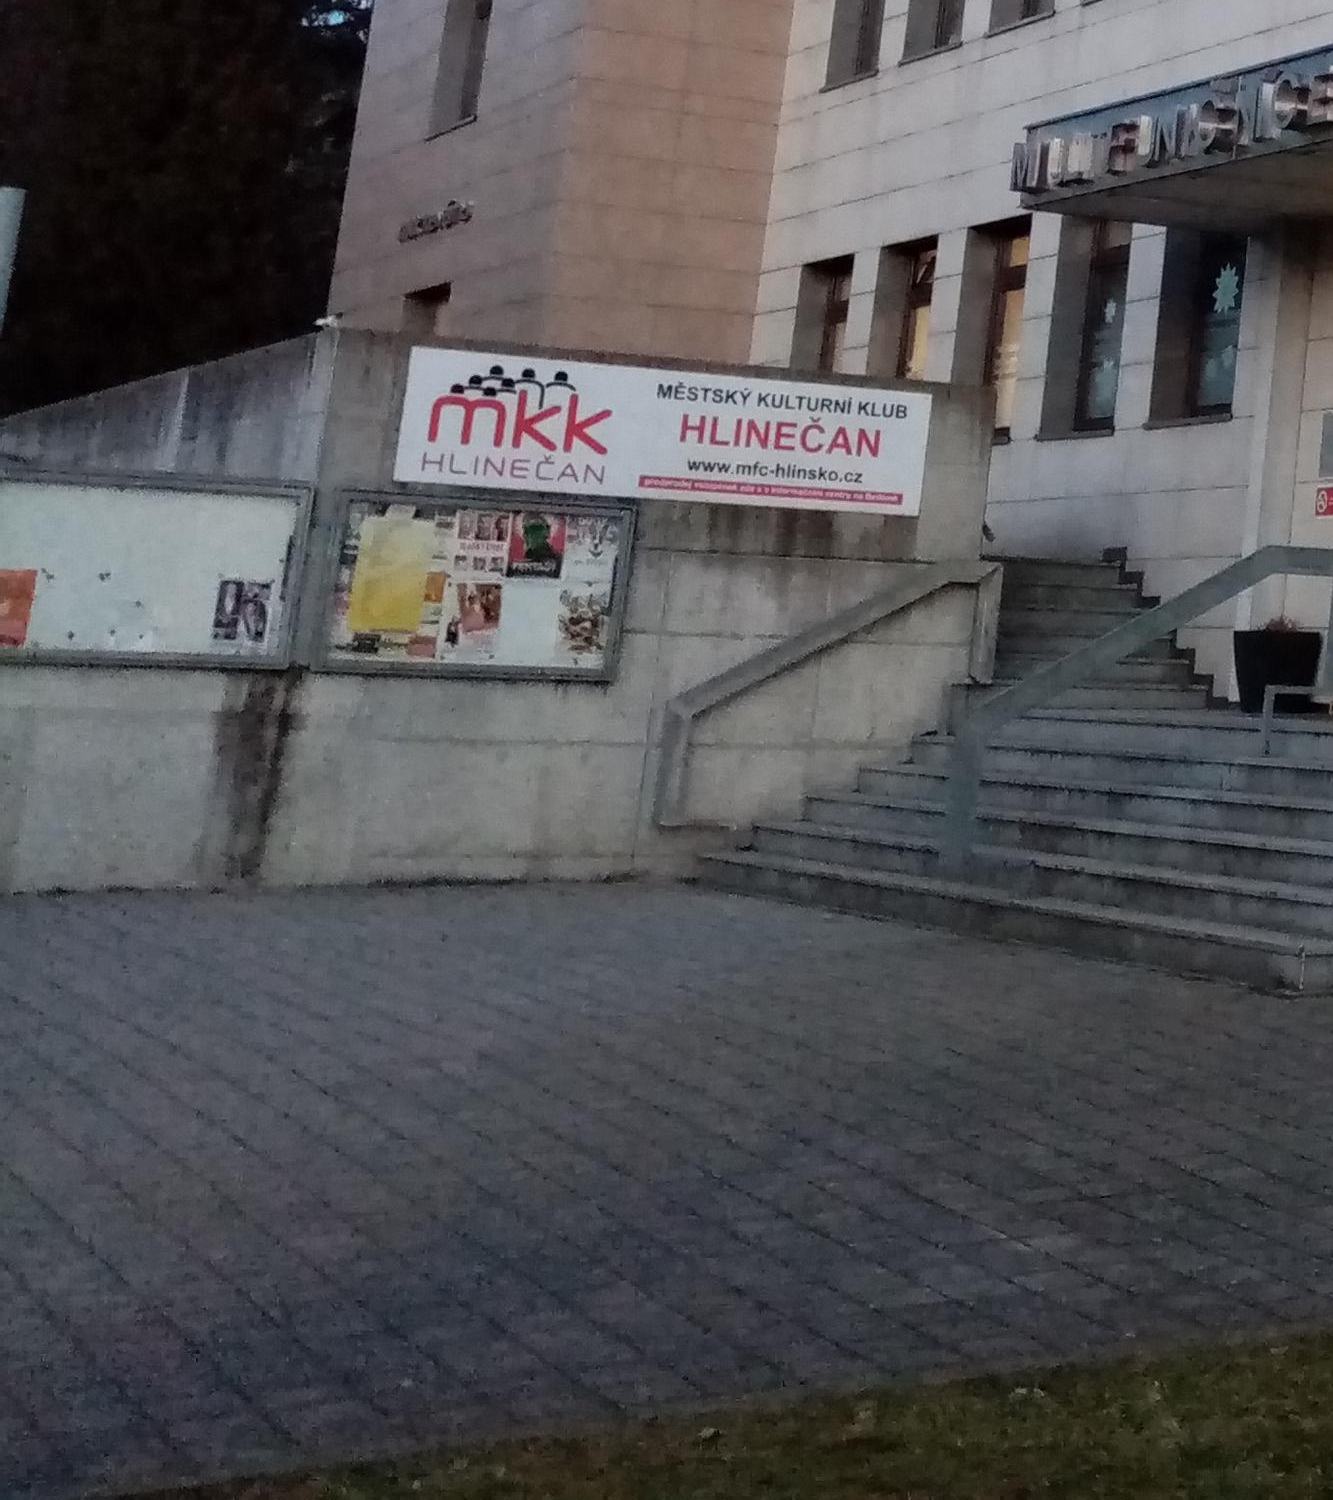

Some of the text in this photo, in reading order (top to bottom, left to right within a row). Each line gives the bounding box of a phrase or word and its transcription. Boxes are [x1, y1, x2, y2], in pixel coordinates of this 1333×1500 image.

[656, 381, 908, 419] MĚSTSKÝ KULTURNÍ KLUB
[427, 389, 613, 455] mkk
[679, 413, 881, 458] HLINEČAN
[421, 452, 606, 485] HLINEČAN
[687, 459, 863, 484] www.mfc-hlinsko.cz
